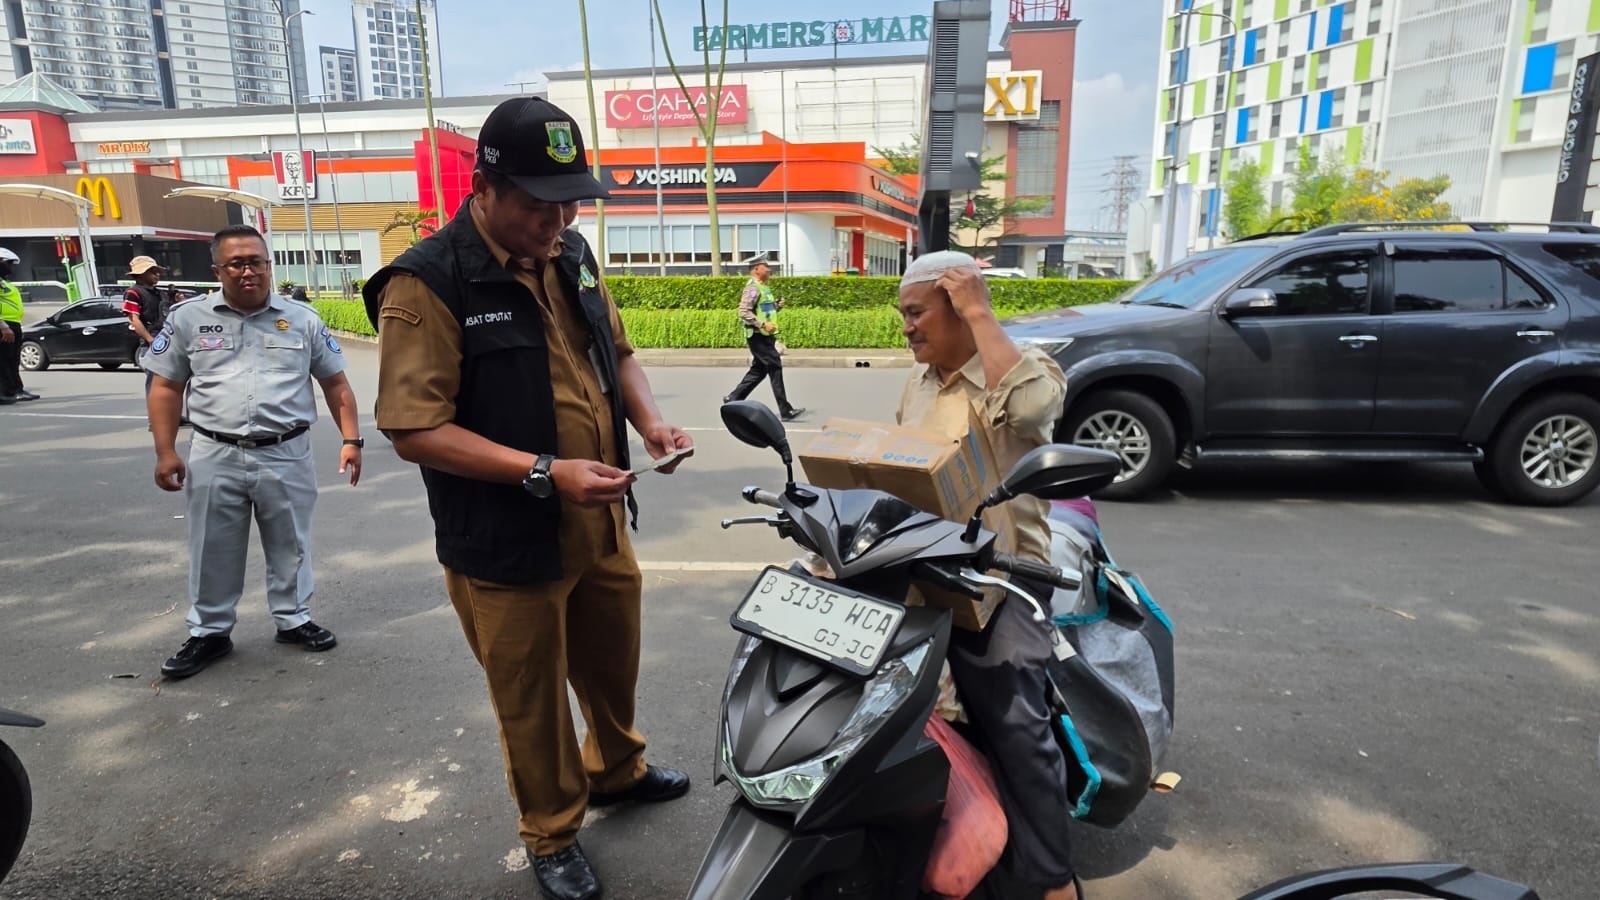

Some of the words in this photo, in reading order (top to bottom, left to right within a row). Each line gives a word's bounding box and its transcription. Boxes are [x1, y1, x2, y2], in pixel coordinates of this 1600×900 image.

[693, 20, 826, 51] FARMERS
[484, 311, 513, 323] CIPUTAT
[199, 325, 224, 334] EKO
[760, 576, 778, 594] B
[781, 582, 839, 615] 3135
[845, 603, 893, 636] WCA
